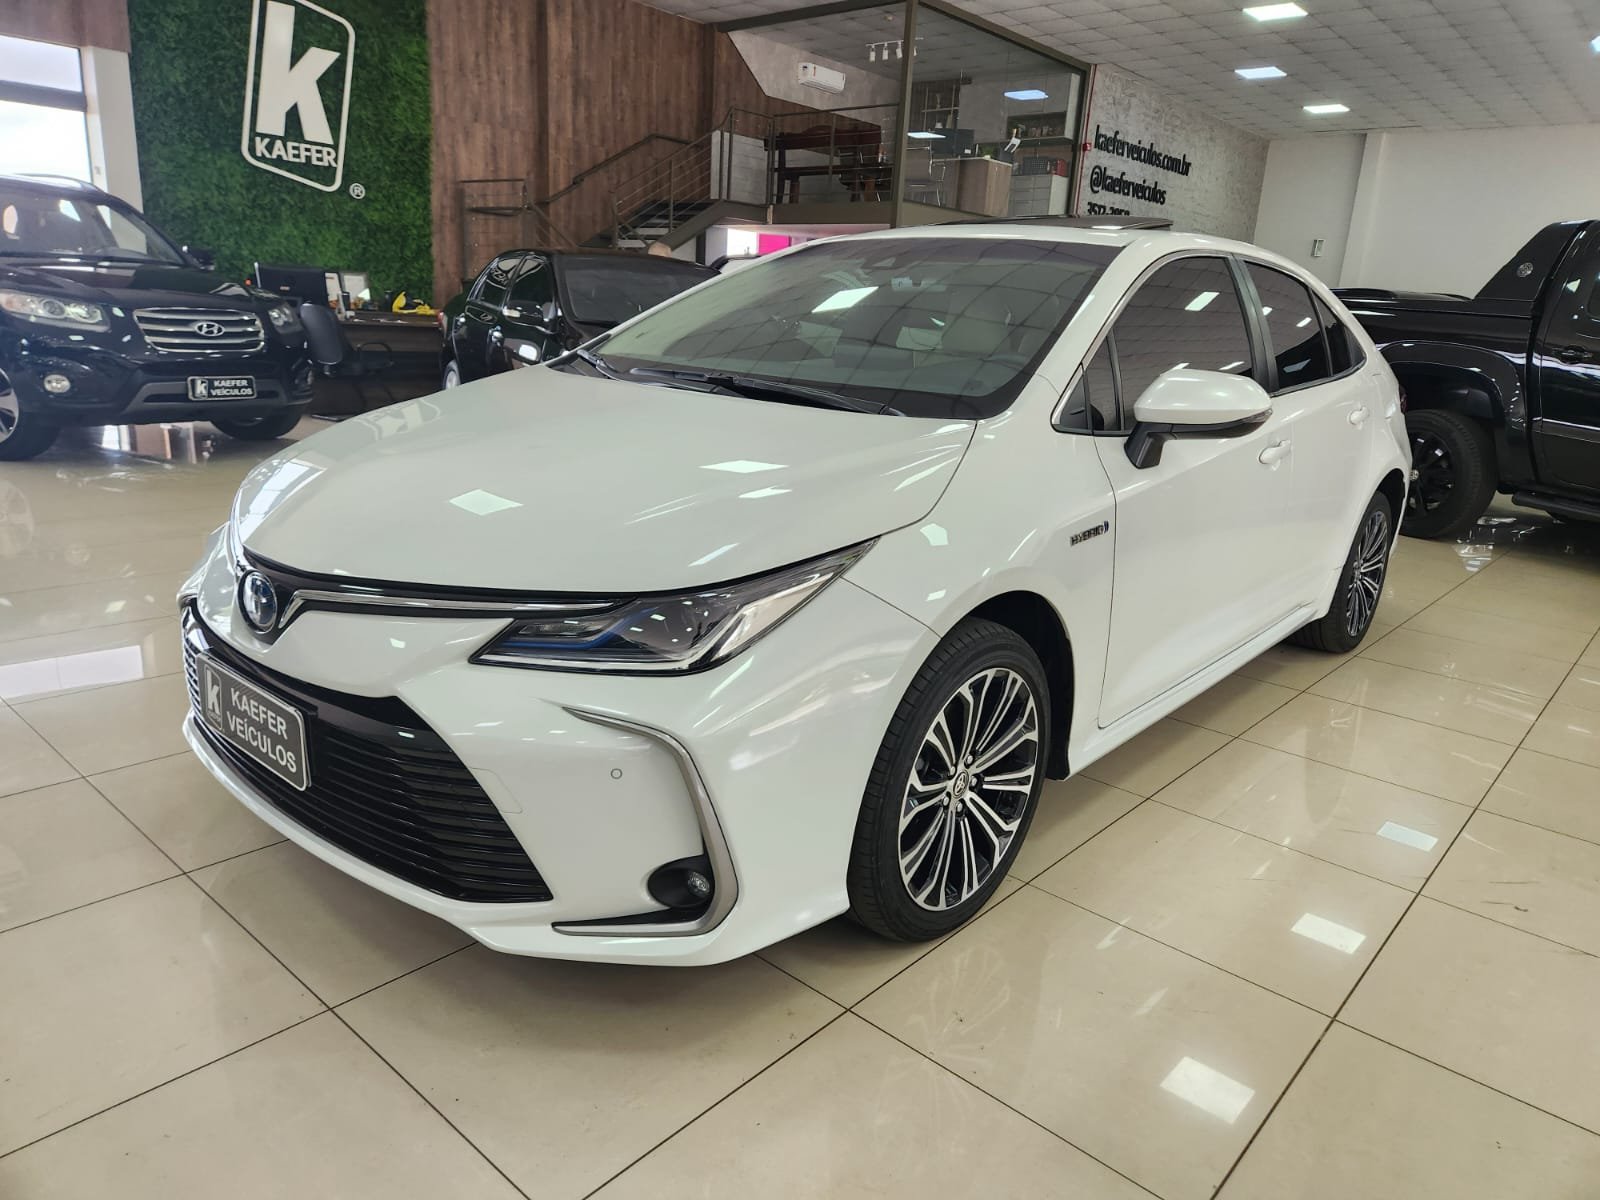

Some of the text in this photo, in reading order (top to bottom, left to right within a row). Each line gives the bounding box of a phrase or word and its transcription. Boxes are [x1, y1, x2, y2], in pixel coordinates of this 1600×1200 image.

[255, 137, 338, 167] KAEFER
[213, 379, 248, 387] KAEFER
[1070, 524, 1104, 546] HYBRID
[231, 687, 288, 740] KAEFER
[226, 711, 297, 773] VEÍCULOS
